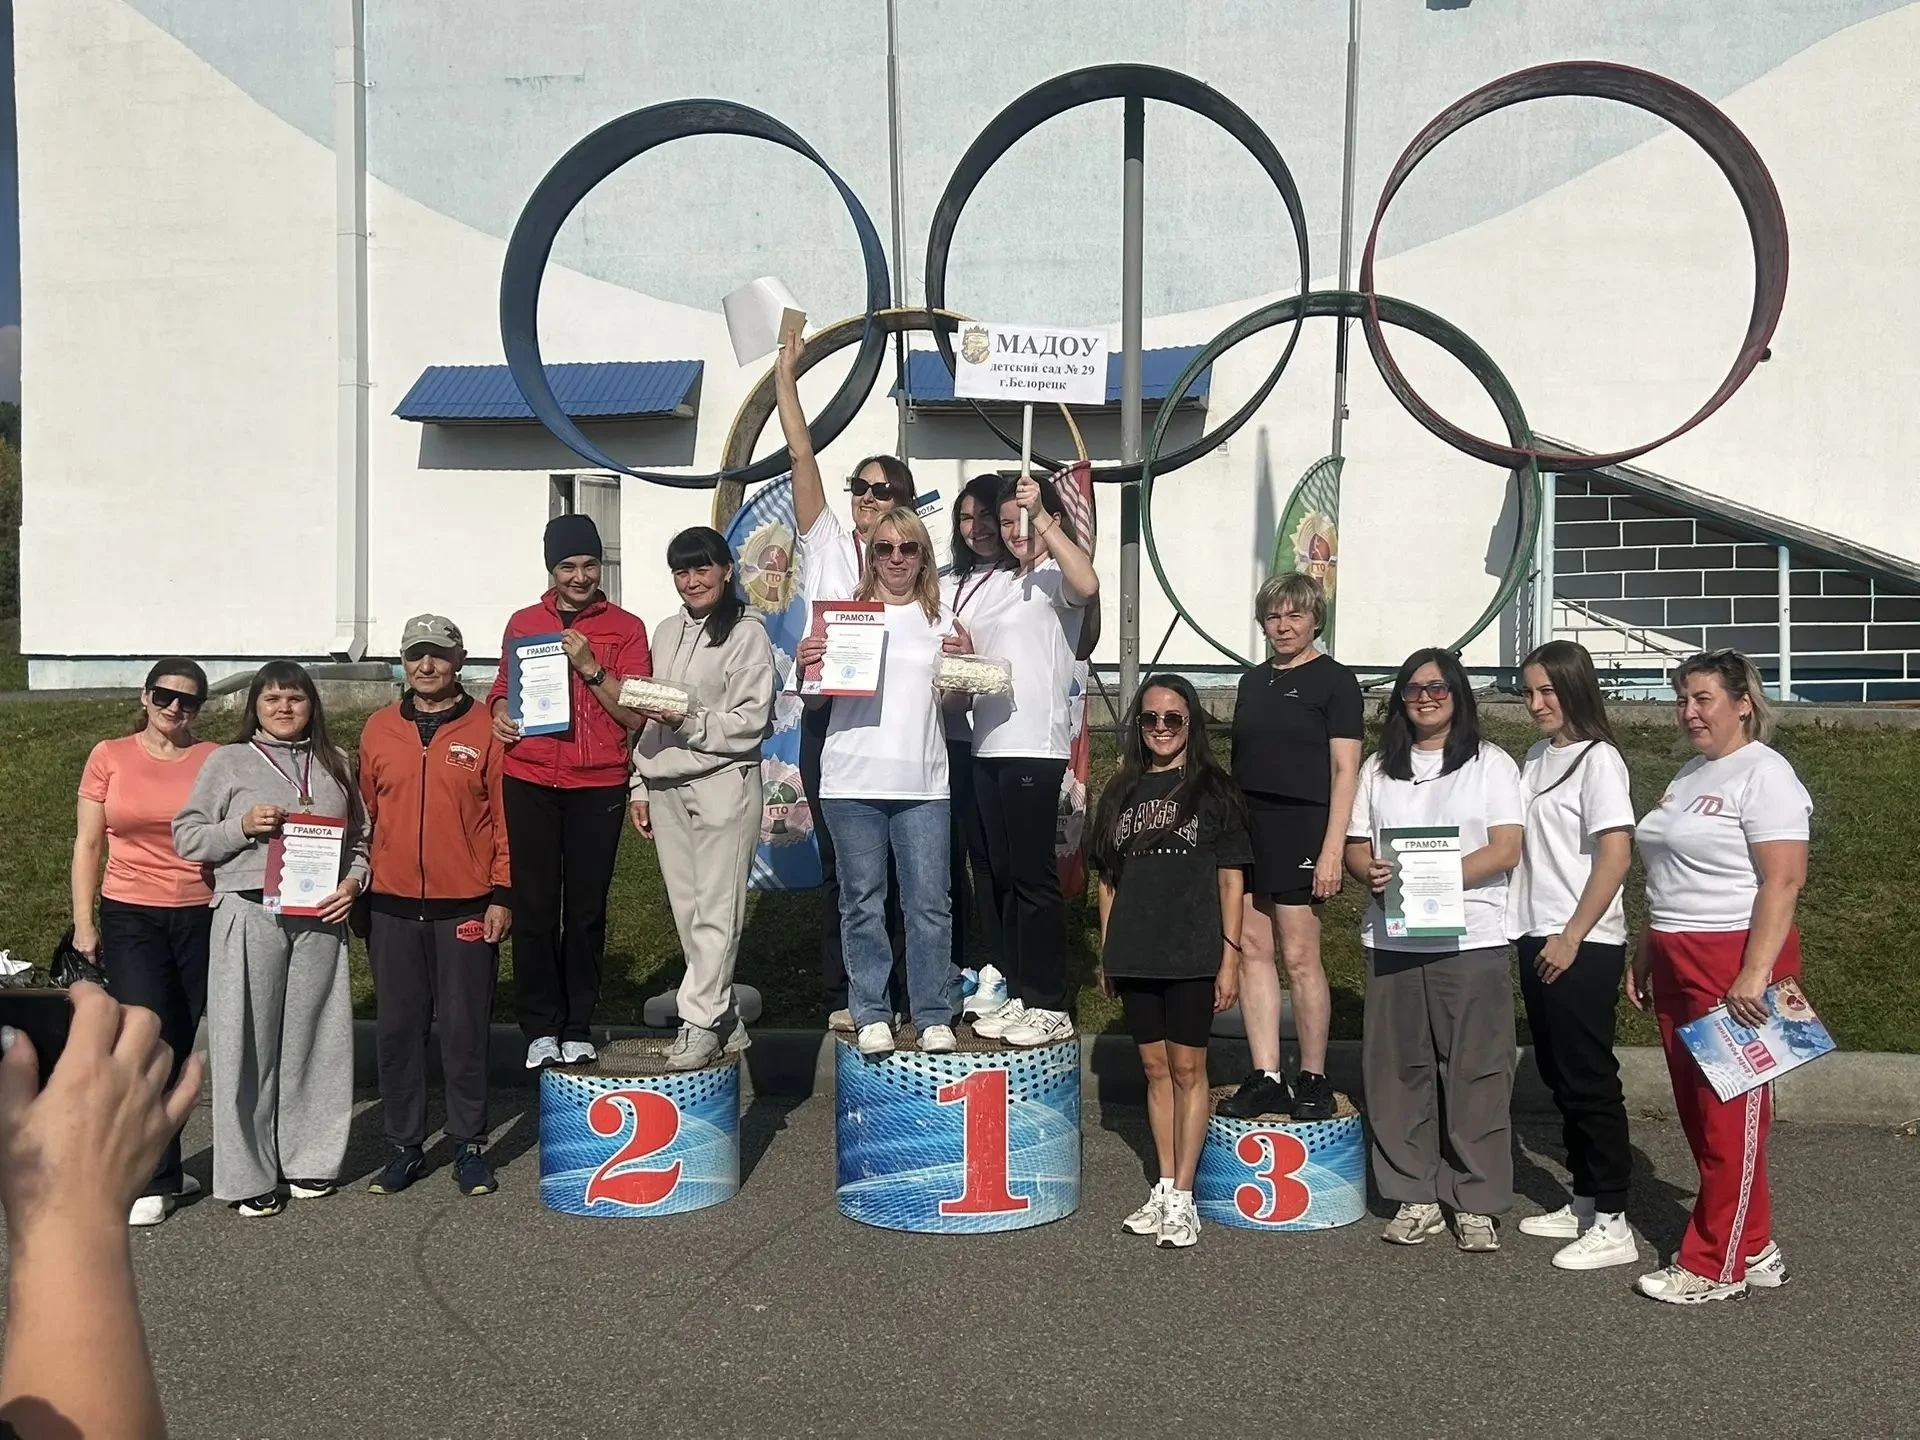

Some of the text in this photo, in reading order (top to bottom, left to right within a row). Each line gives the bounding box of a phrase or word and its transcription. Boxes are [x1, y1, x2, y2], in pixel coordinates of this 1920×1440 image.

[996, 334, 1099, 359] МАДОУ
[990, 362, 1095, 376] детский сад № 29
[1000, 377, 1067, 391] г.Белорецк
[1311, 563, 1325, 572] ГТО
[765, 572, 782, 582] ГТО
[835, 613, 875, 622] ГРАМОТА
[526, 645, 560, 656] ГРАМОТА
[768, 806, 789, 816] ГТО
[293, 826, 333, 836] ГРАМОТА
[1404, 840, 1449, 849] ГРАМОТА
[584, 1089, 683, 1206] 2
[936, 1067, 1030, 1217] 1
[1234, 1129, 1312, 1225] 3
